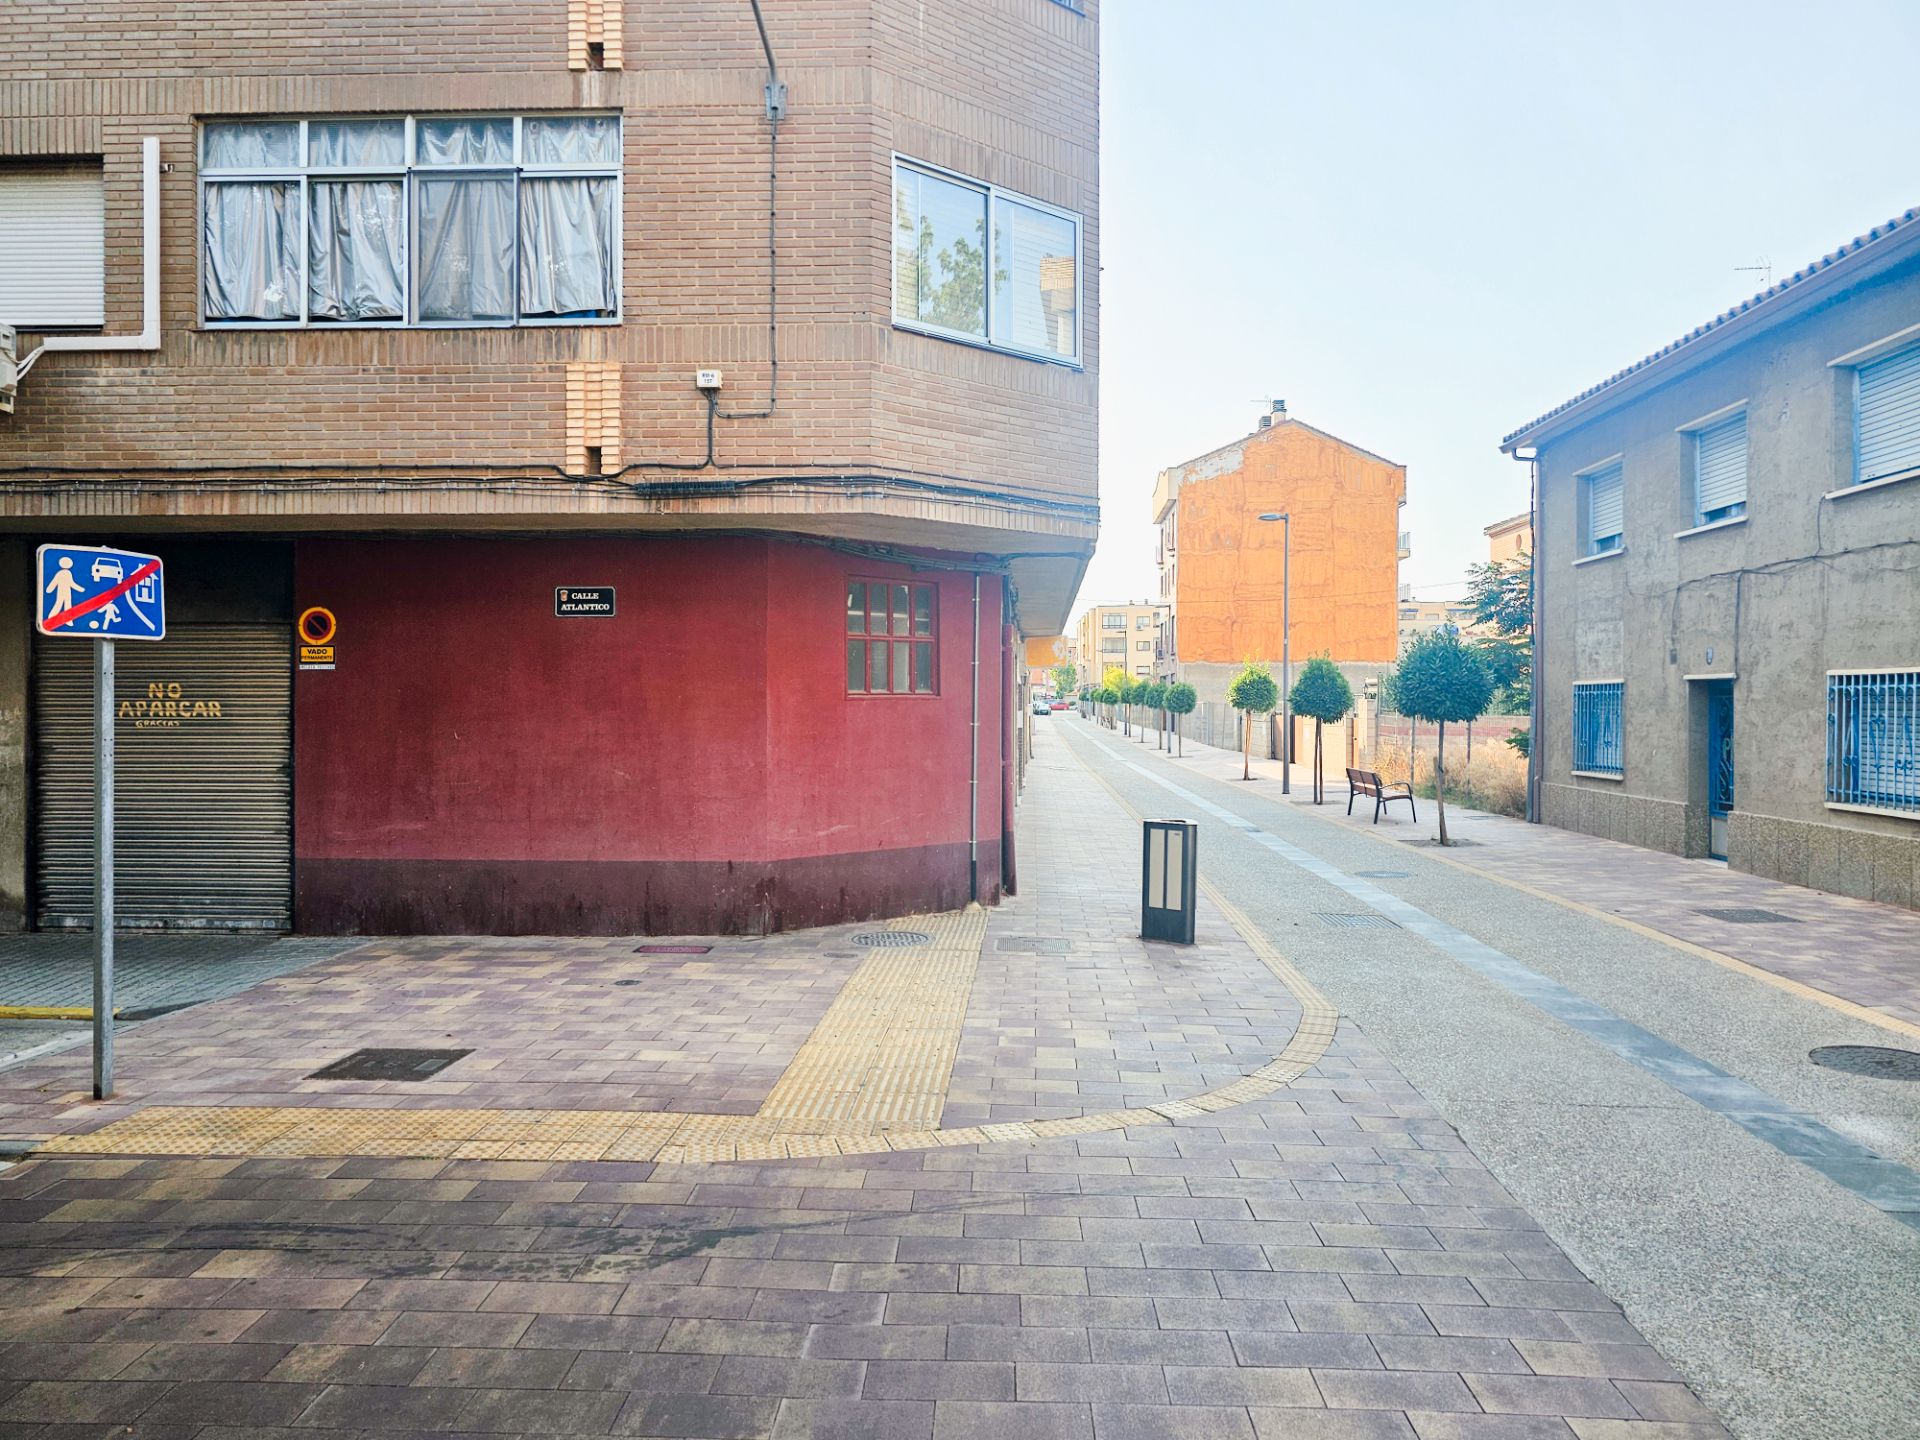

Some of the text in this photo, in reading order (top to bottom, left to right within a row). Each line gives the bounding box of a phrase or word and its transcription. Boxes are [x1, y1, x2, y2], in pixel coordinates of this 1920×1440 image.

[571, 592, 599, 600] CALLE
[560, 603, 610, 611] ATLANTICO
[148, 682, 181, 699] NO
[118, 701, 221, 718] APARCAR
[135, 719, 180, 728] GRACIAS
